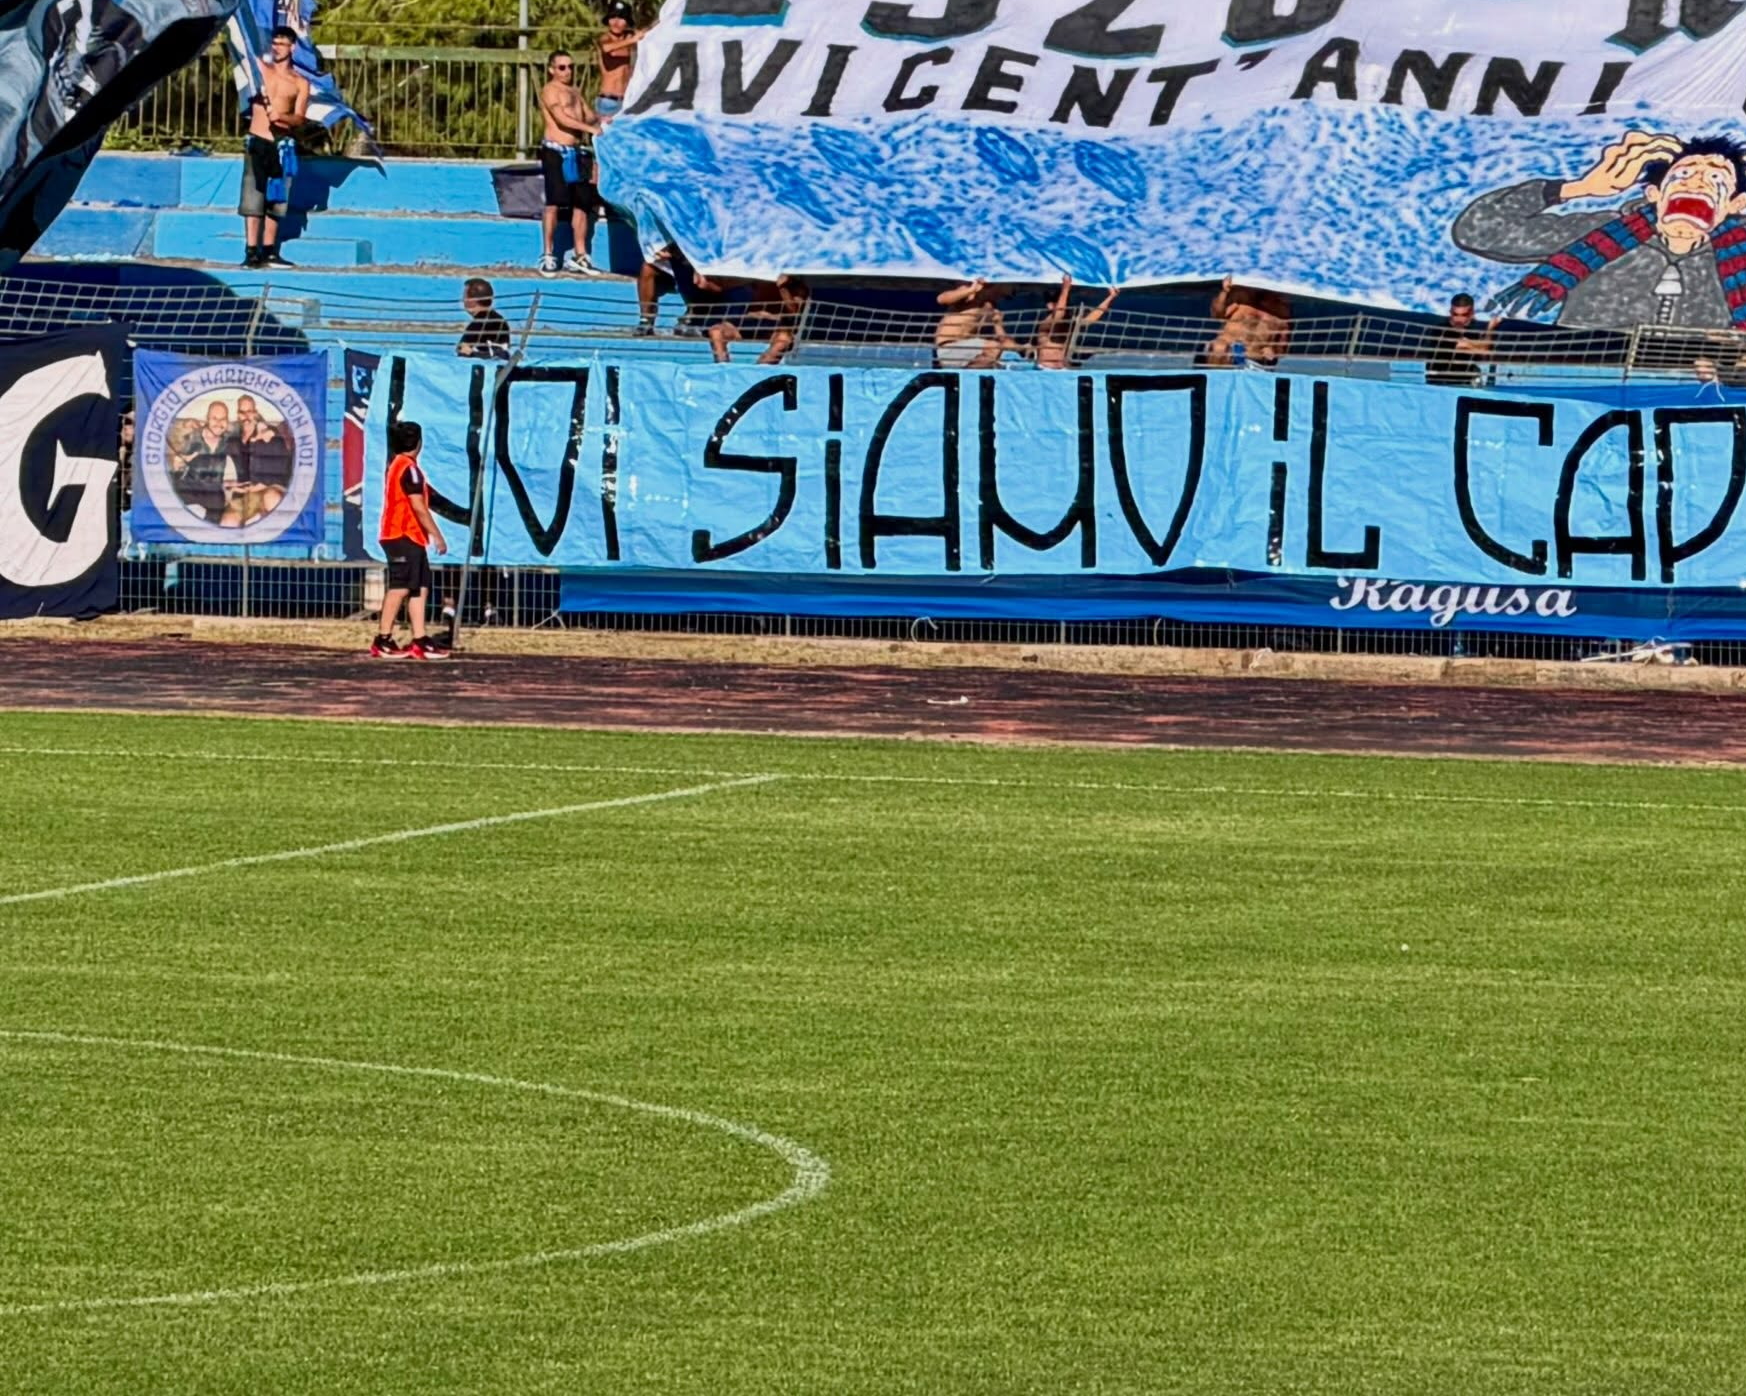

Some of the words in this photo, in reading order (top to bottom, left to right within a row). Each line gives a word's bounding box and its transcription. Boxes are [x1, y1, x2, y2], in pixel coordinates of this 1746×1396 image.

[146, 389, 182, 466] GIORGIO
[279, 392, 309, 430] CON
[299, 434, 315, 467] NOI
[1330, 574, 1577, 628] Ragusa
